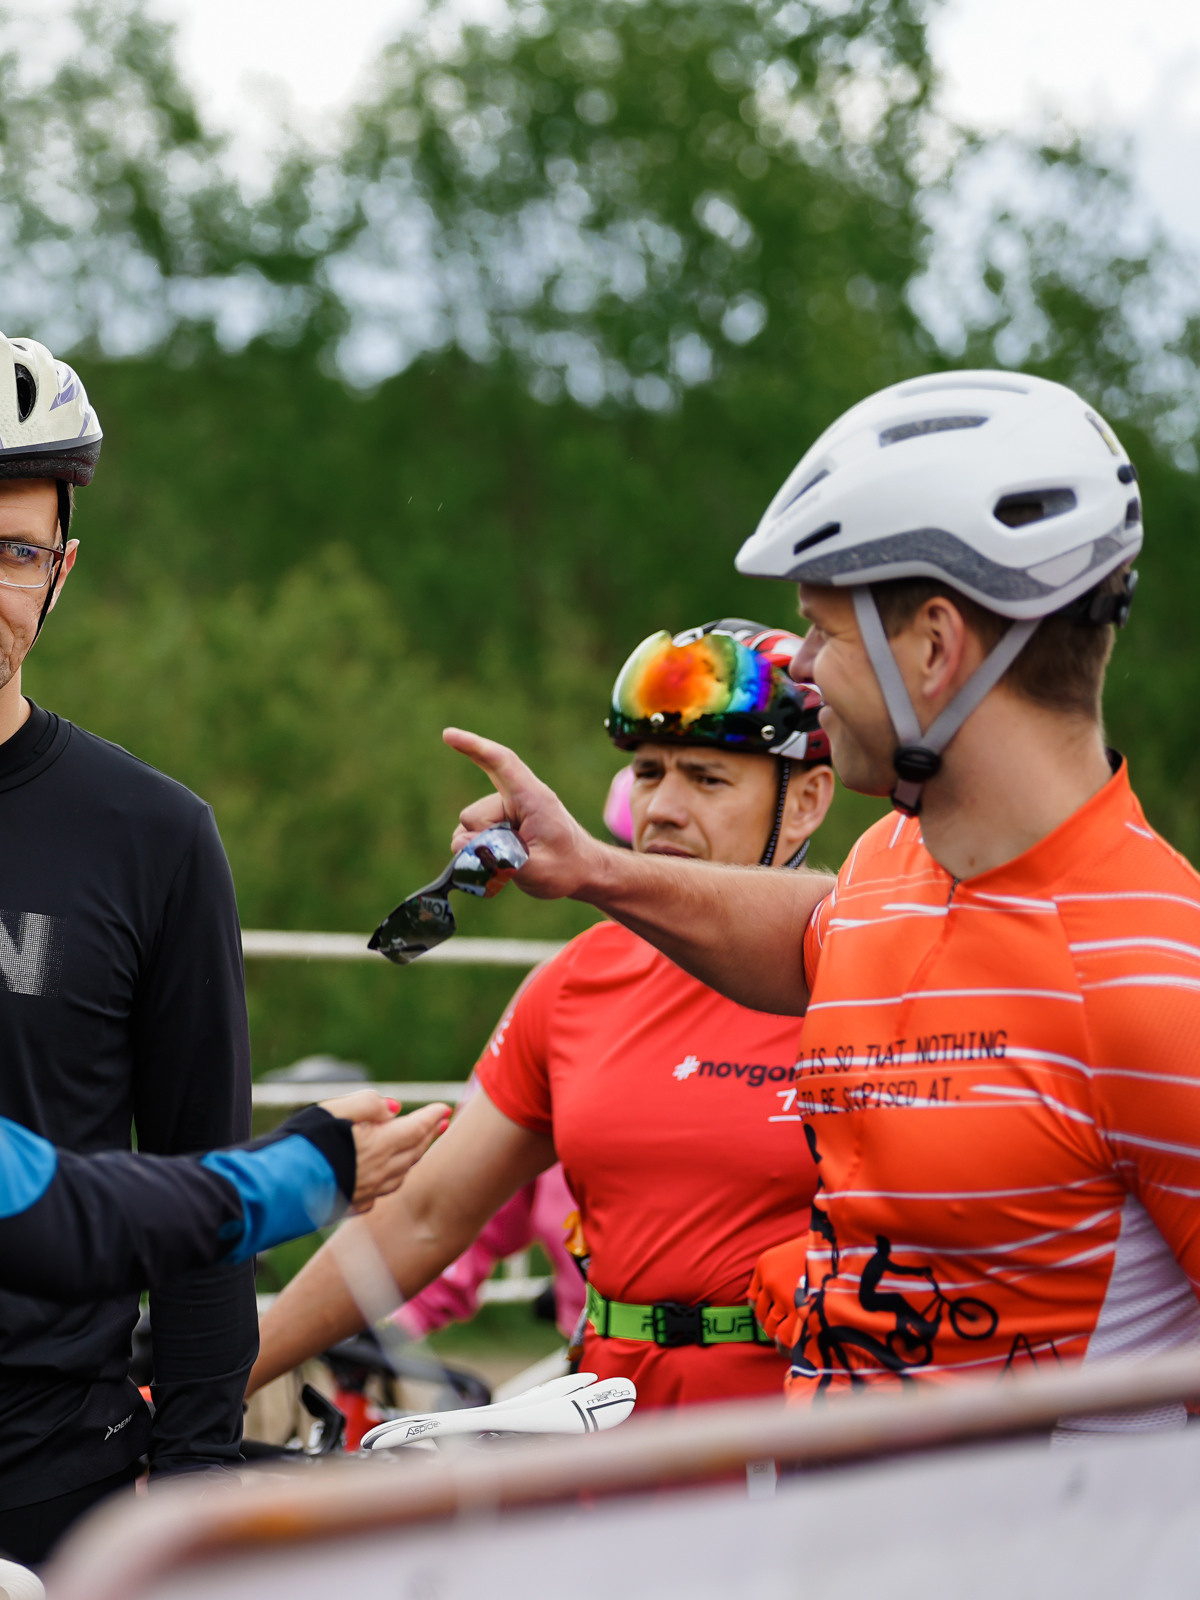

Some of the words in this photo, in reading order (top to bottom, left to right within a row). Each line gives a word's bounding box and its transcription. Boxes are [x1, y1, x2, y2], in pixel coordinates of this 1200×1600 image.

[810, 1047, 826, 1075] IS
[834, 1045, 854, 1073] SO
[914, 1030, 1007, 1065] NOTHING
[820, 1088, 836, 1115] BE
